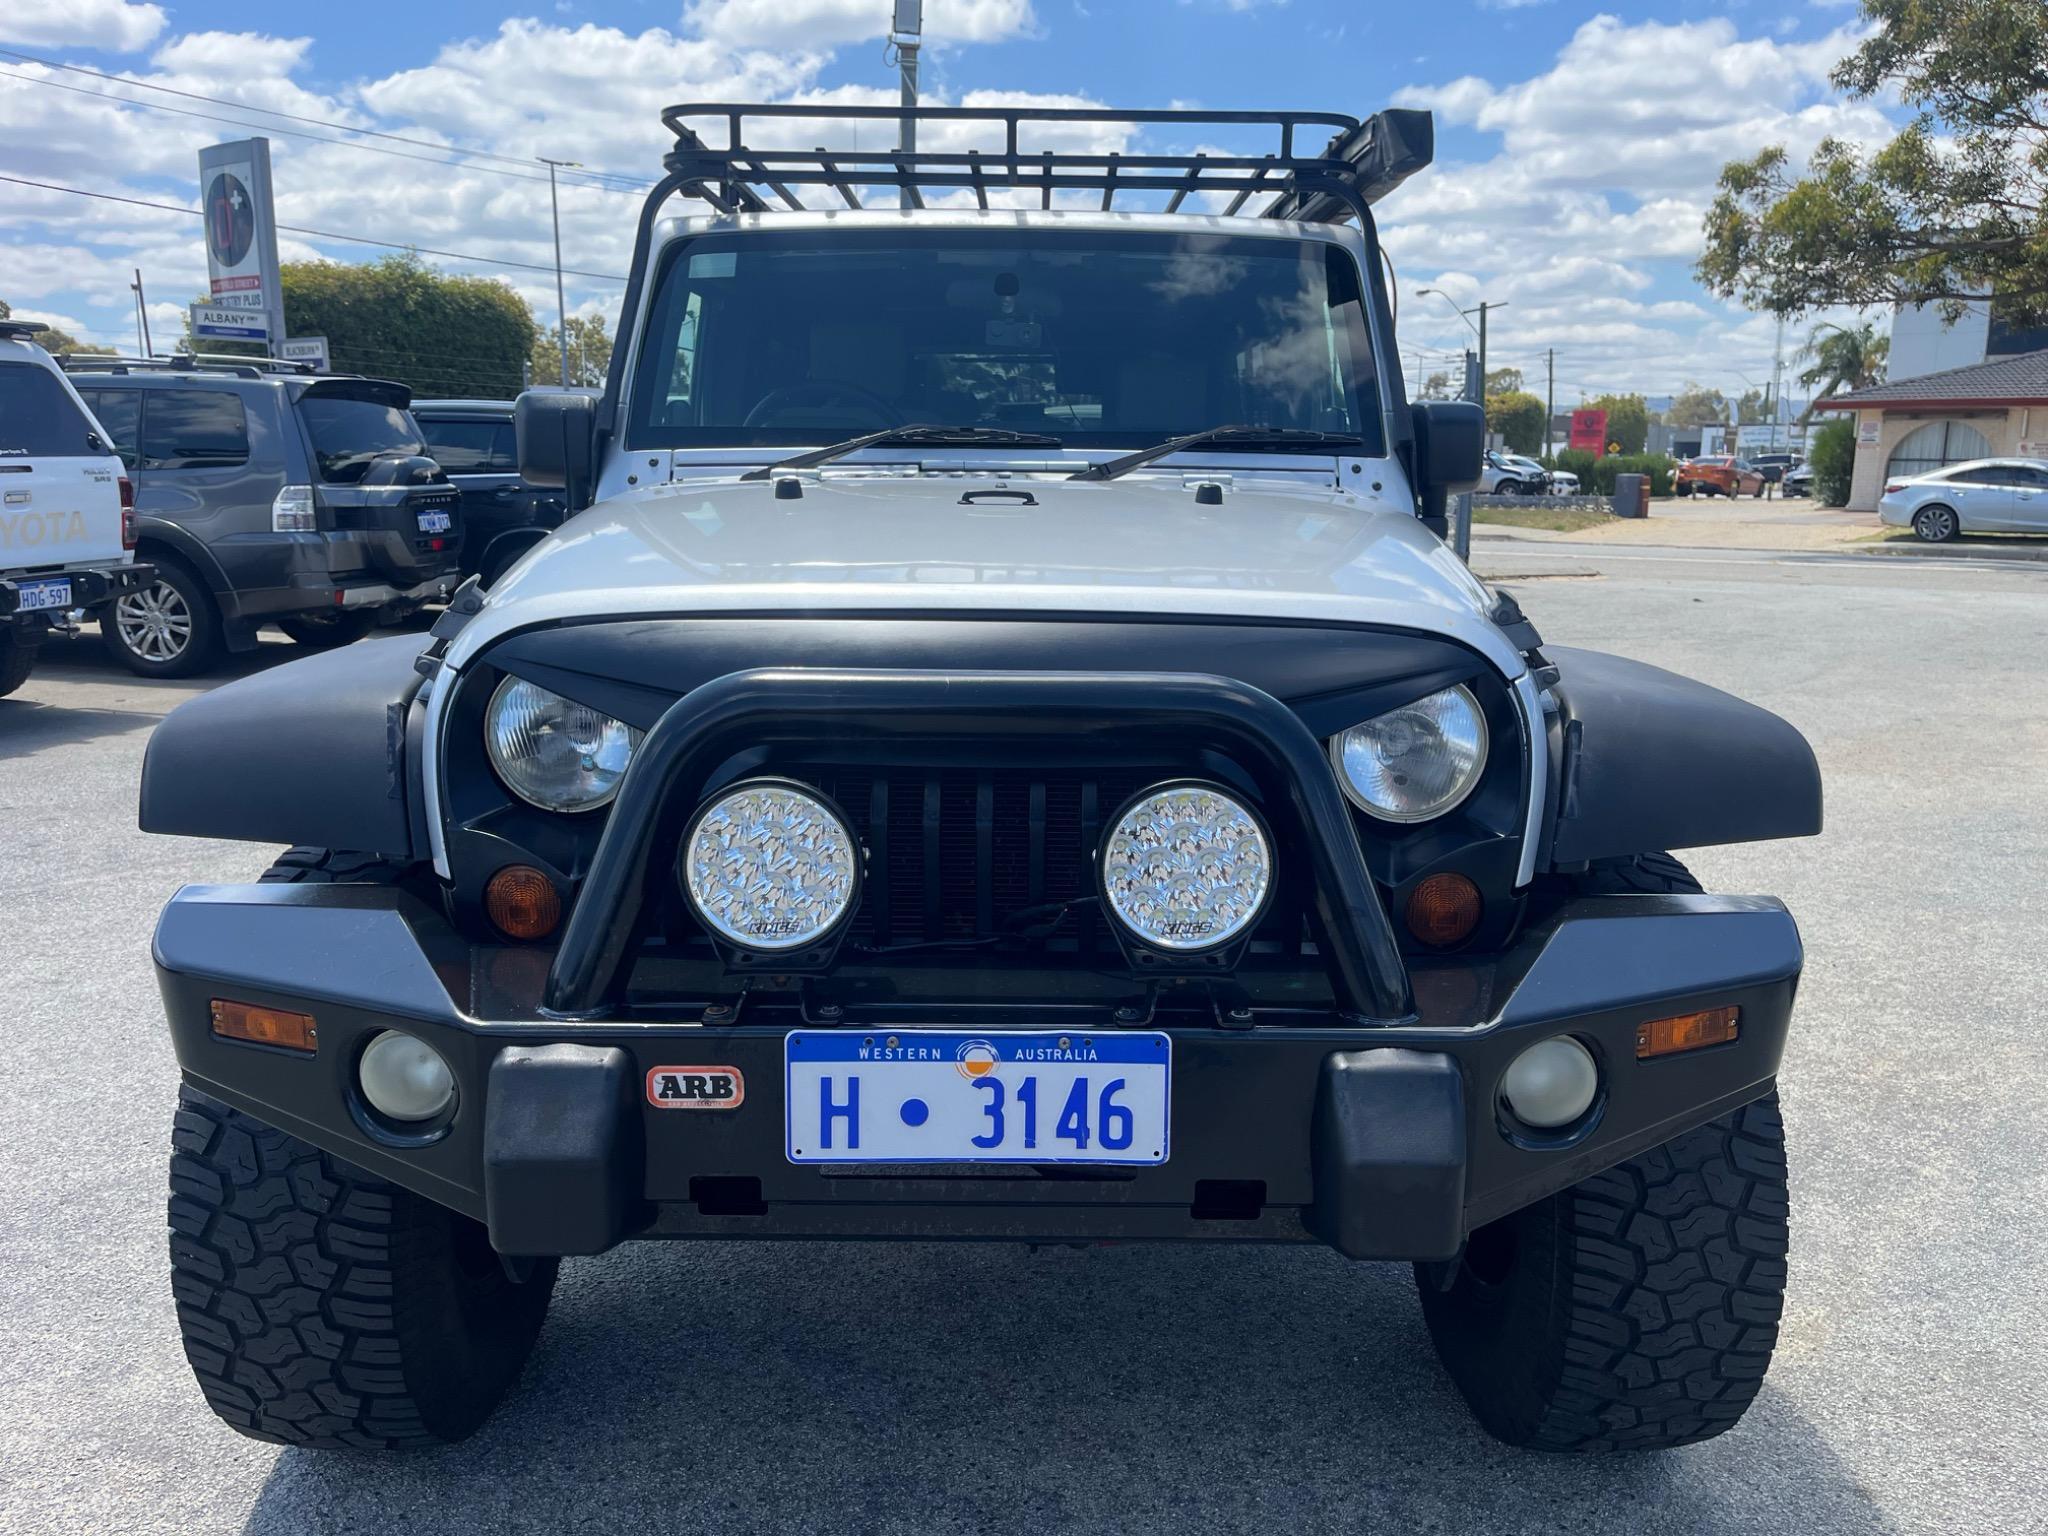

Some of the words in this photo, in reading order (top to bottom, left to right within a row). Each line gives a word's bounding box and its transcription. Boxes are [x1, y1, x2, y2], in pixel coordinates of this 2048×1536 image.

[243, 293, 261, 306] PLUS
[203, 312, 245, 325] ALBANY
[22, 591, 45, 609] HDG
[49, 588, 68, 605] 597
[749, 921, 800, 934] KINGS
[1161, 921, 1213, 935] KINGS
[858, 1047, 942, 1060] WESTERN
[1015, 1048, 1098, 1061] AUSTRALIA
[659, 1075, 733, 1099] ARB
[820, 1076, 860, 1150] H
[970, 1076, 1134, 1151] 3146
